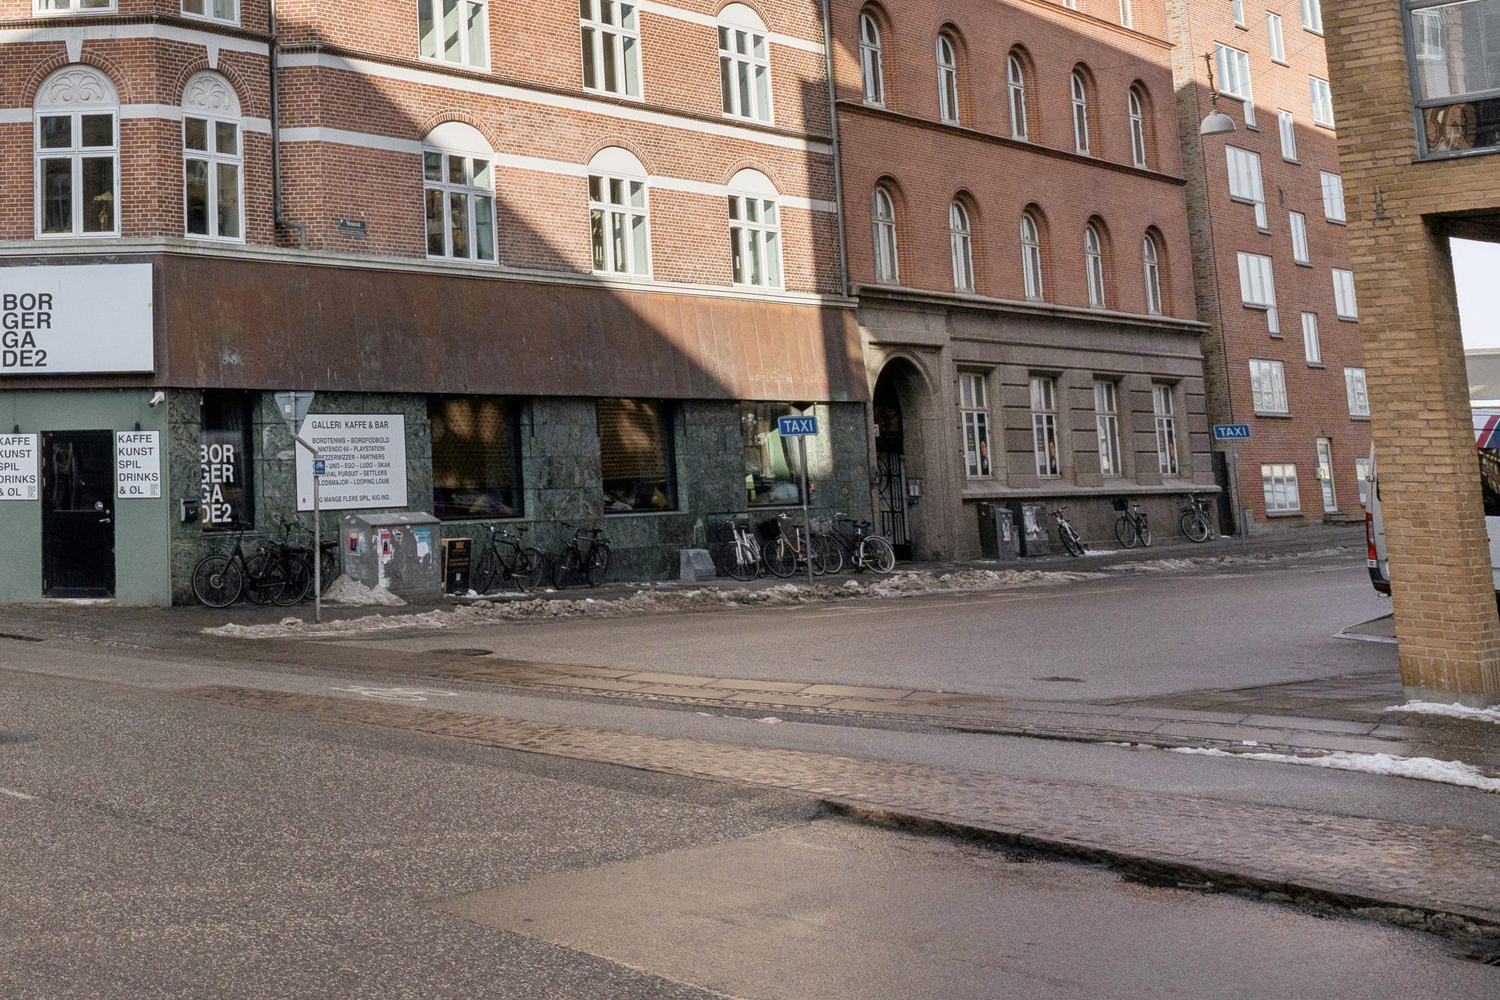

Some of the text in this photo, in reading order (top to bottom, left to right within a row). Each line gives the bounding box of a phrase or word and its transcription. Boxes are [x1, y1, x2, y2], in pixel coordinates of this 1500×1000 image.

[3, 293, 53, 311] BOR
[2, 312, 52, 330] GER
[2, 331, 37, 349] GA
[2, 350, 47, 367] DE2
[312, 421, 342, 429] GALLERI
[345, 421, 367, 429] KAFFE
[783, 419, 814, 433] TAXI
[1218, 426, 1247, 437] TAXI
[118, 434, 153, 443] KAFFE
[118, 447, 154, 456] KUNST
[200, 443, 234, 463] BOR
[118, 460, 141, 469] SPIL
[119, 473, 159, 482] DRINKS
[201, 464, 234, 483] GER
[7, 487, 22, 496] ØL
[119, 485, 144, 494] & ØL
[201, 484, 224, 503] GA
[201, 503, 232, 523] DE2
